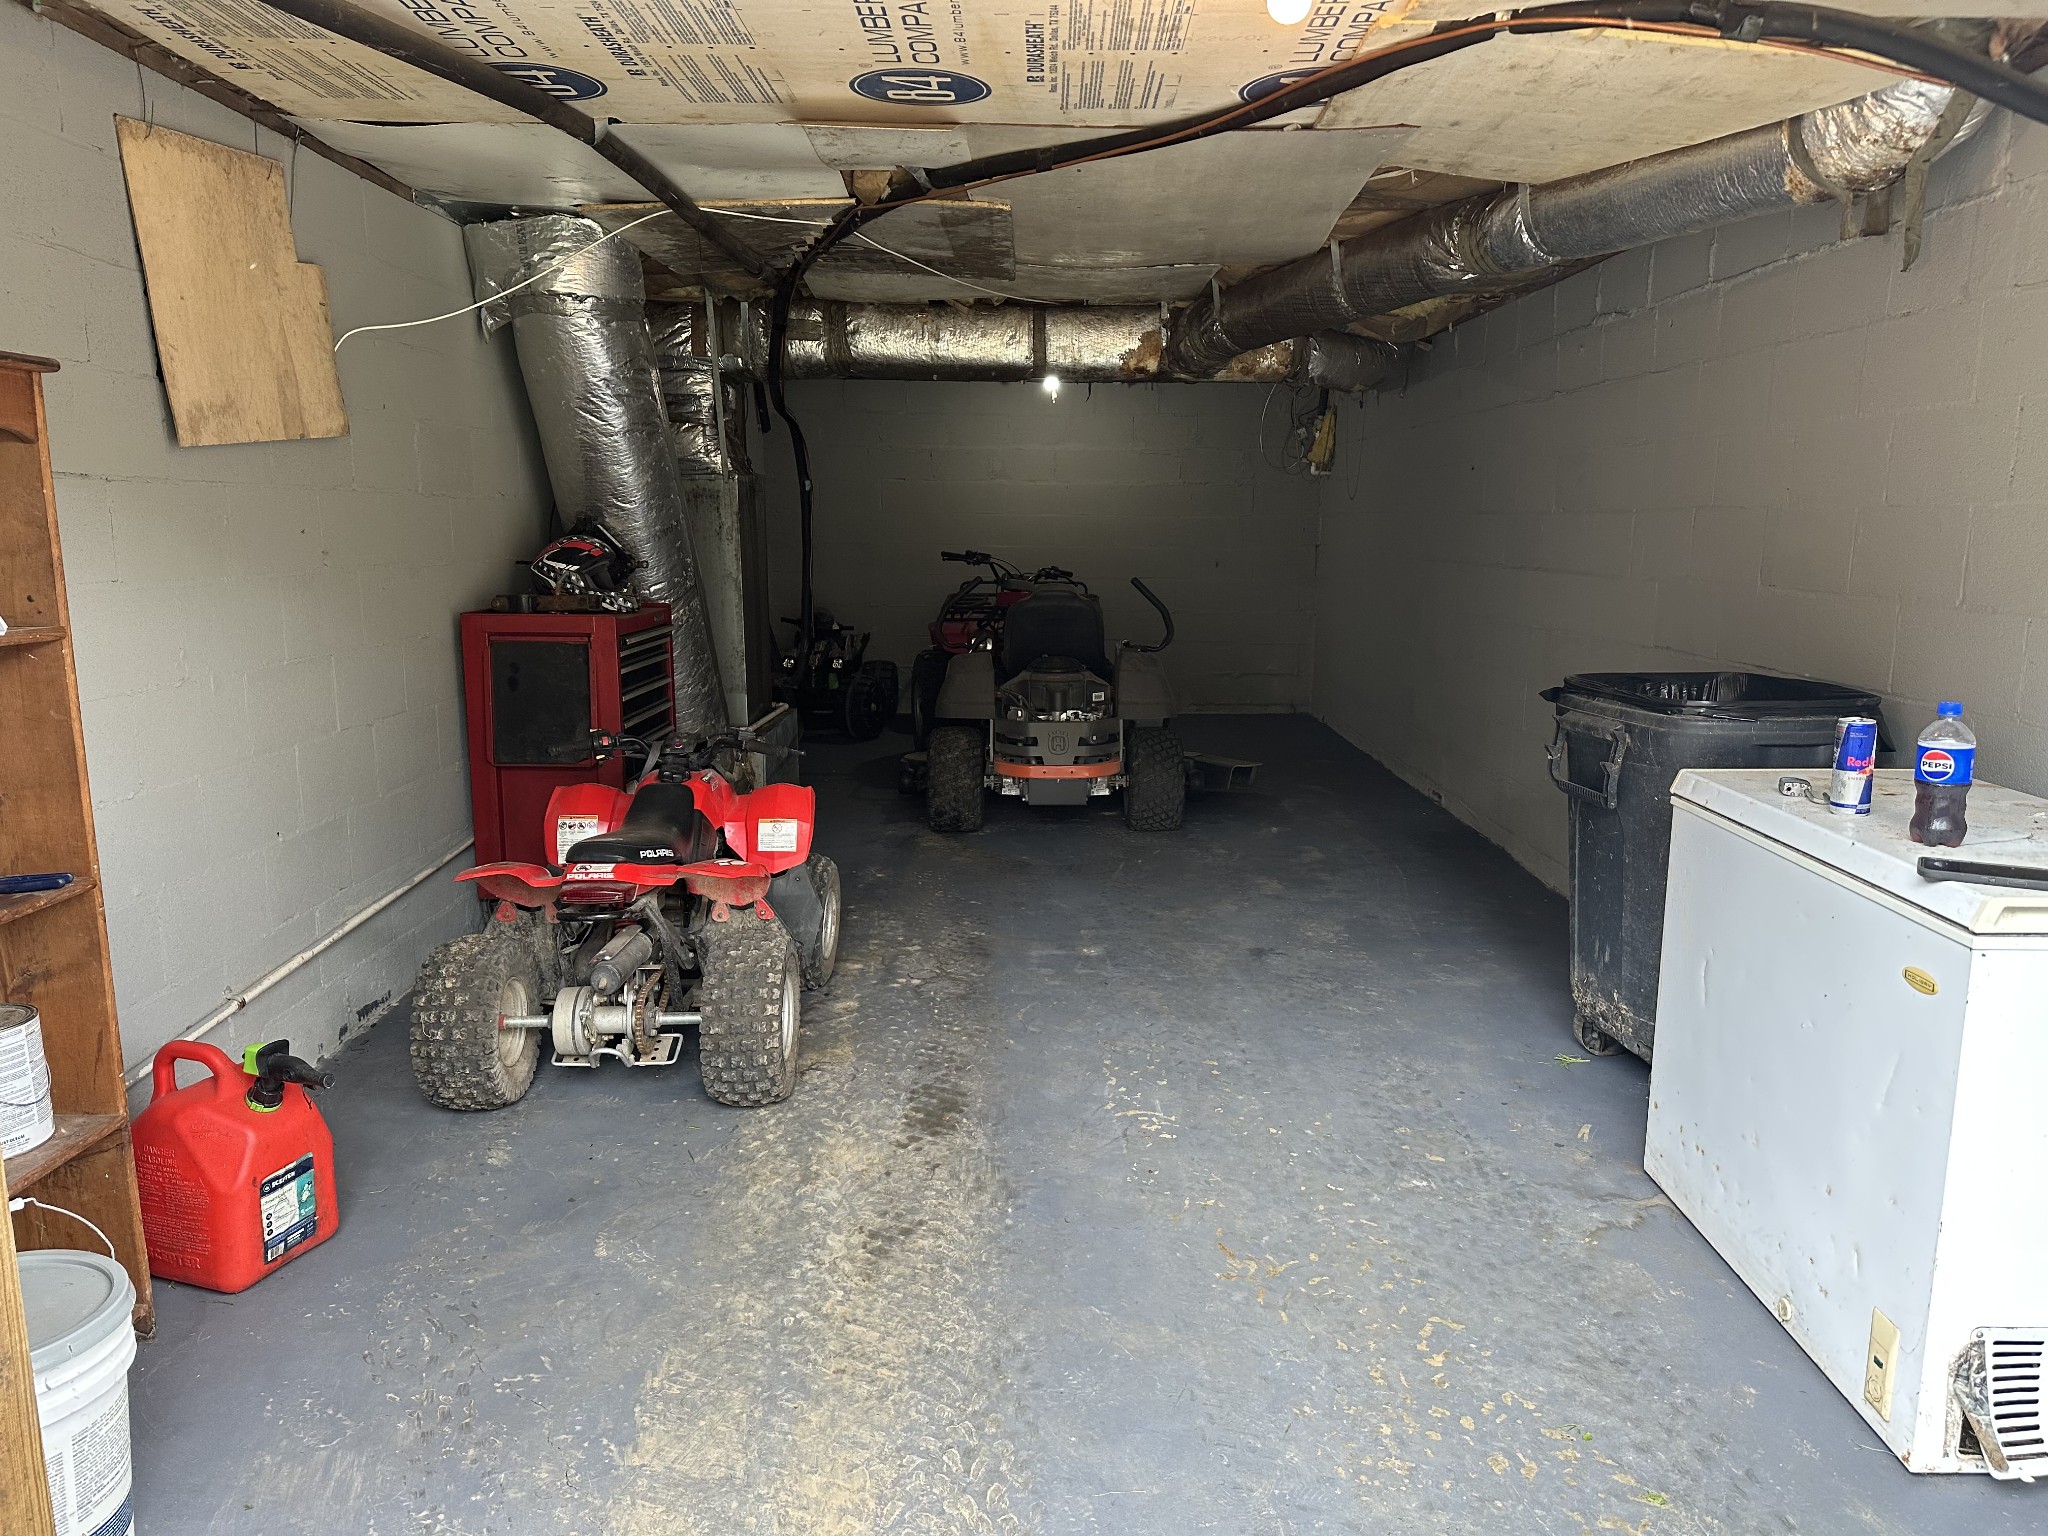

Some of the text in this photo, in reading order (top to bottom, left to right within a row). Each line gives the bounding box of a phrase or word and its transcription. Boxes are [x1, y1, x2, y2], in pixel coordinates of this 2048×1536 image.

[136, 8, 237, 59] DURASHEATH
[399, 0, 490, 57] LUMBE
[579, 16, 639, 66] DURASHEATH
[1024, 22, 1045, 73] DURASHEATH
[881, 75, 957, 101] 84
[1847, 756, 1870, 767] Red
[1922, 760, 1953, 770] PEPSI
[640, 848, 675, 859] POLARIS
[566, 872, 615, 880] POLARIS
